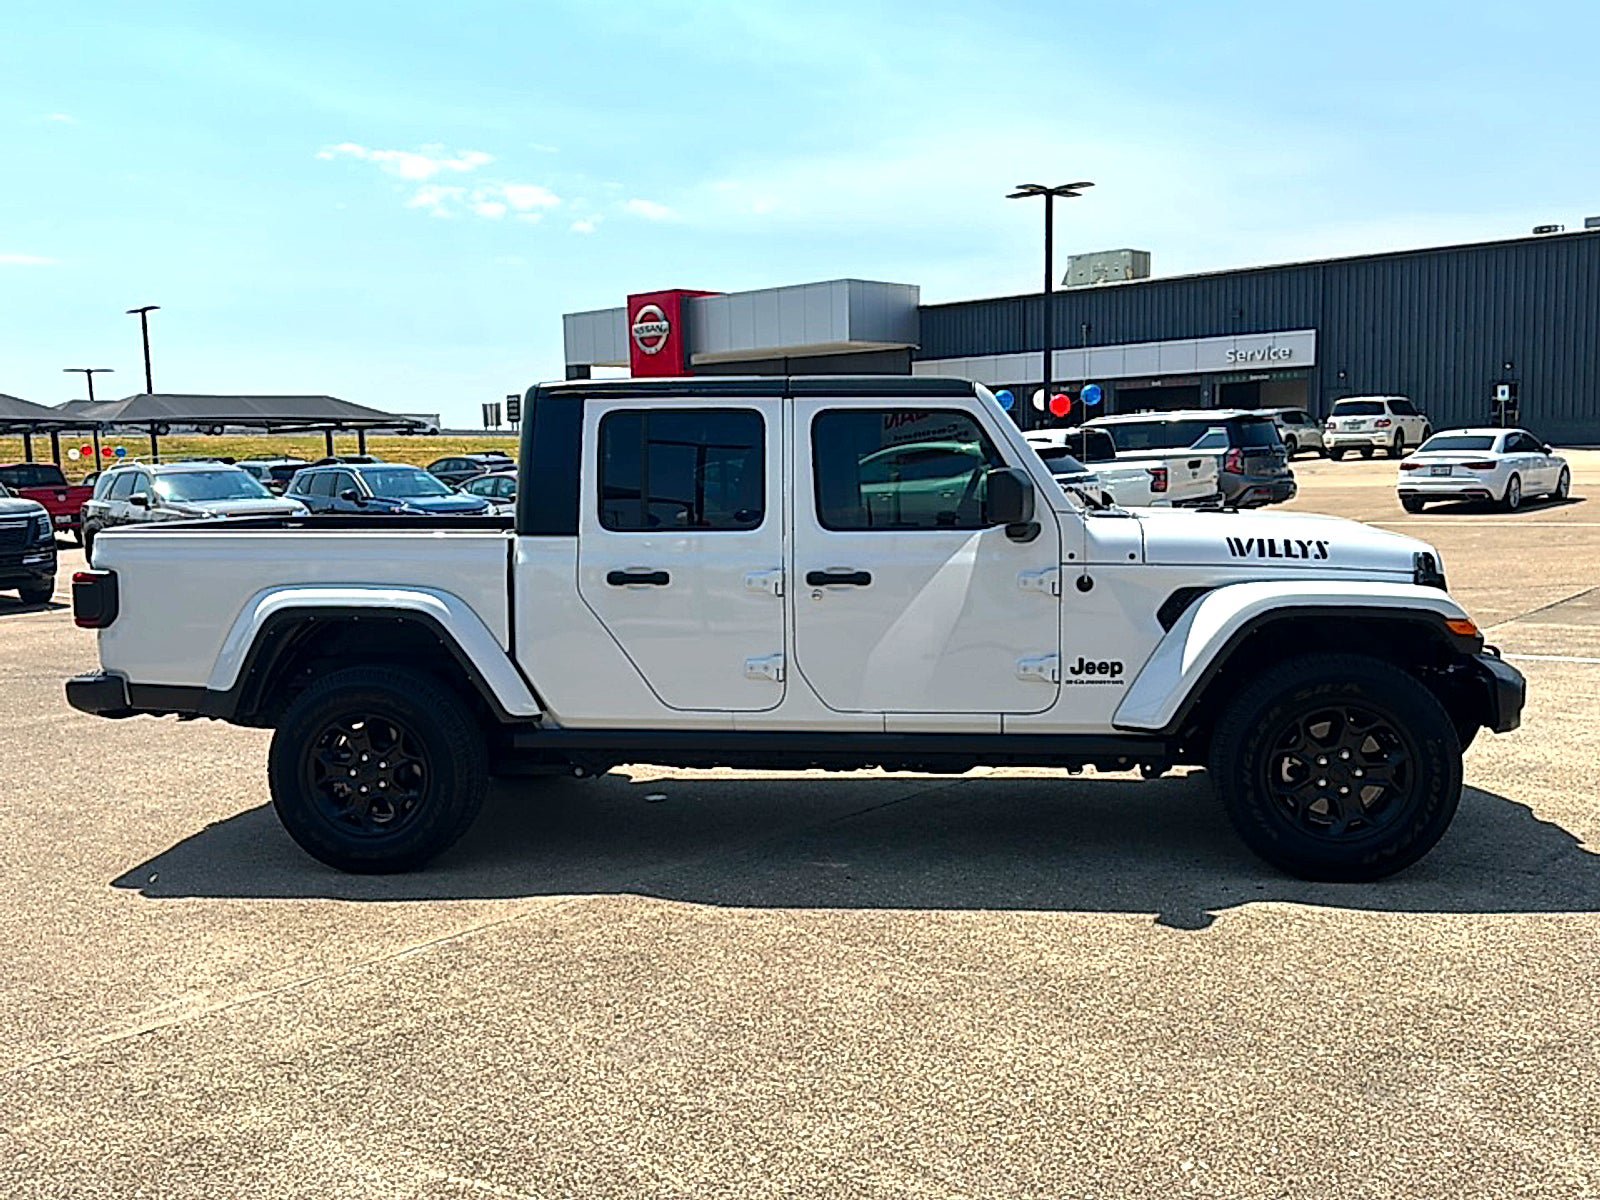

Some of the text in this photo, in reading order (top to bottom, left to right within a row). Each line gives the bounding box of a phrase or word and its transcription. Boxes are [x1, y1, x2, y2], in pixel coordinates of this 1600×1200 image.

[1225, 345, 1291, 363] Service
[1226, 537, 1329, 559] WILLYS
[1070, 657, 1123, 678] Jeep
